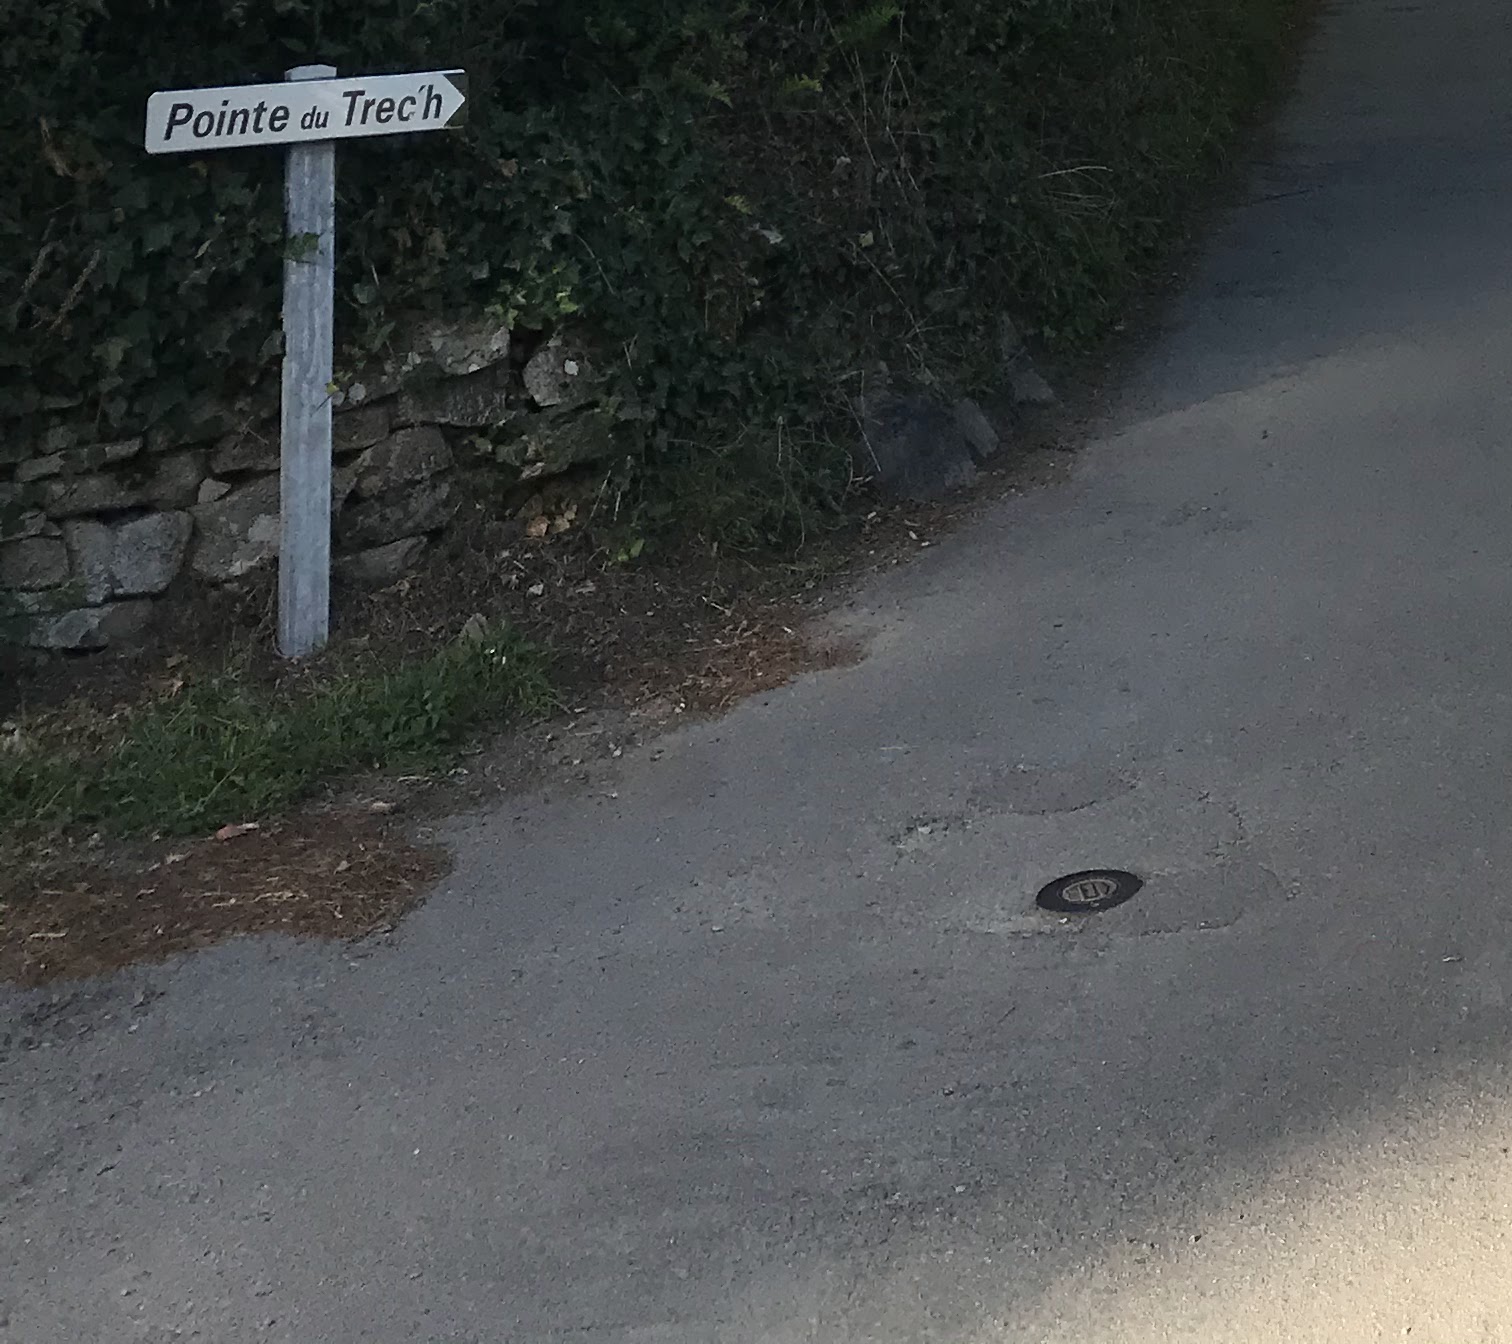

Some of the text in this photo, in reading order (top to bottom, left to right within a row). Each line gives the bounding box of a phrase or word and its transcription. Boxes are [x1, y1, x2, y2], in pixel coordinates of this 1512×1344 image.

[163, 84, 443, 141] Pointe du Trec'h
